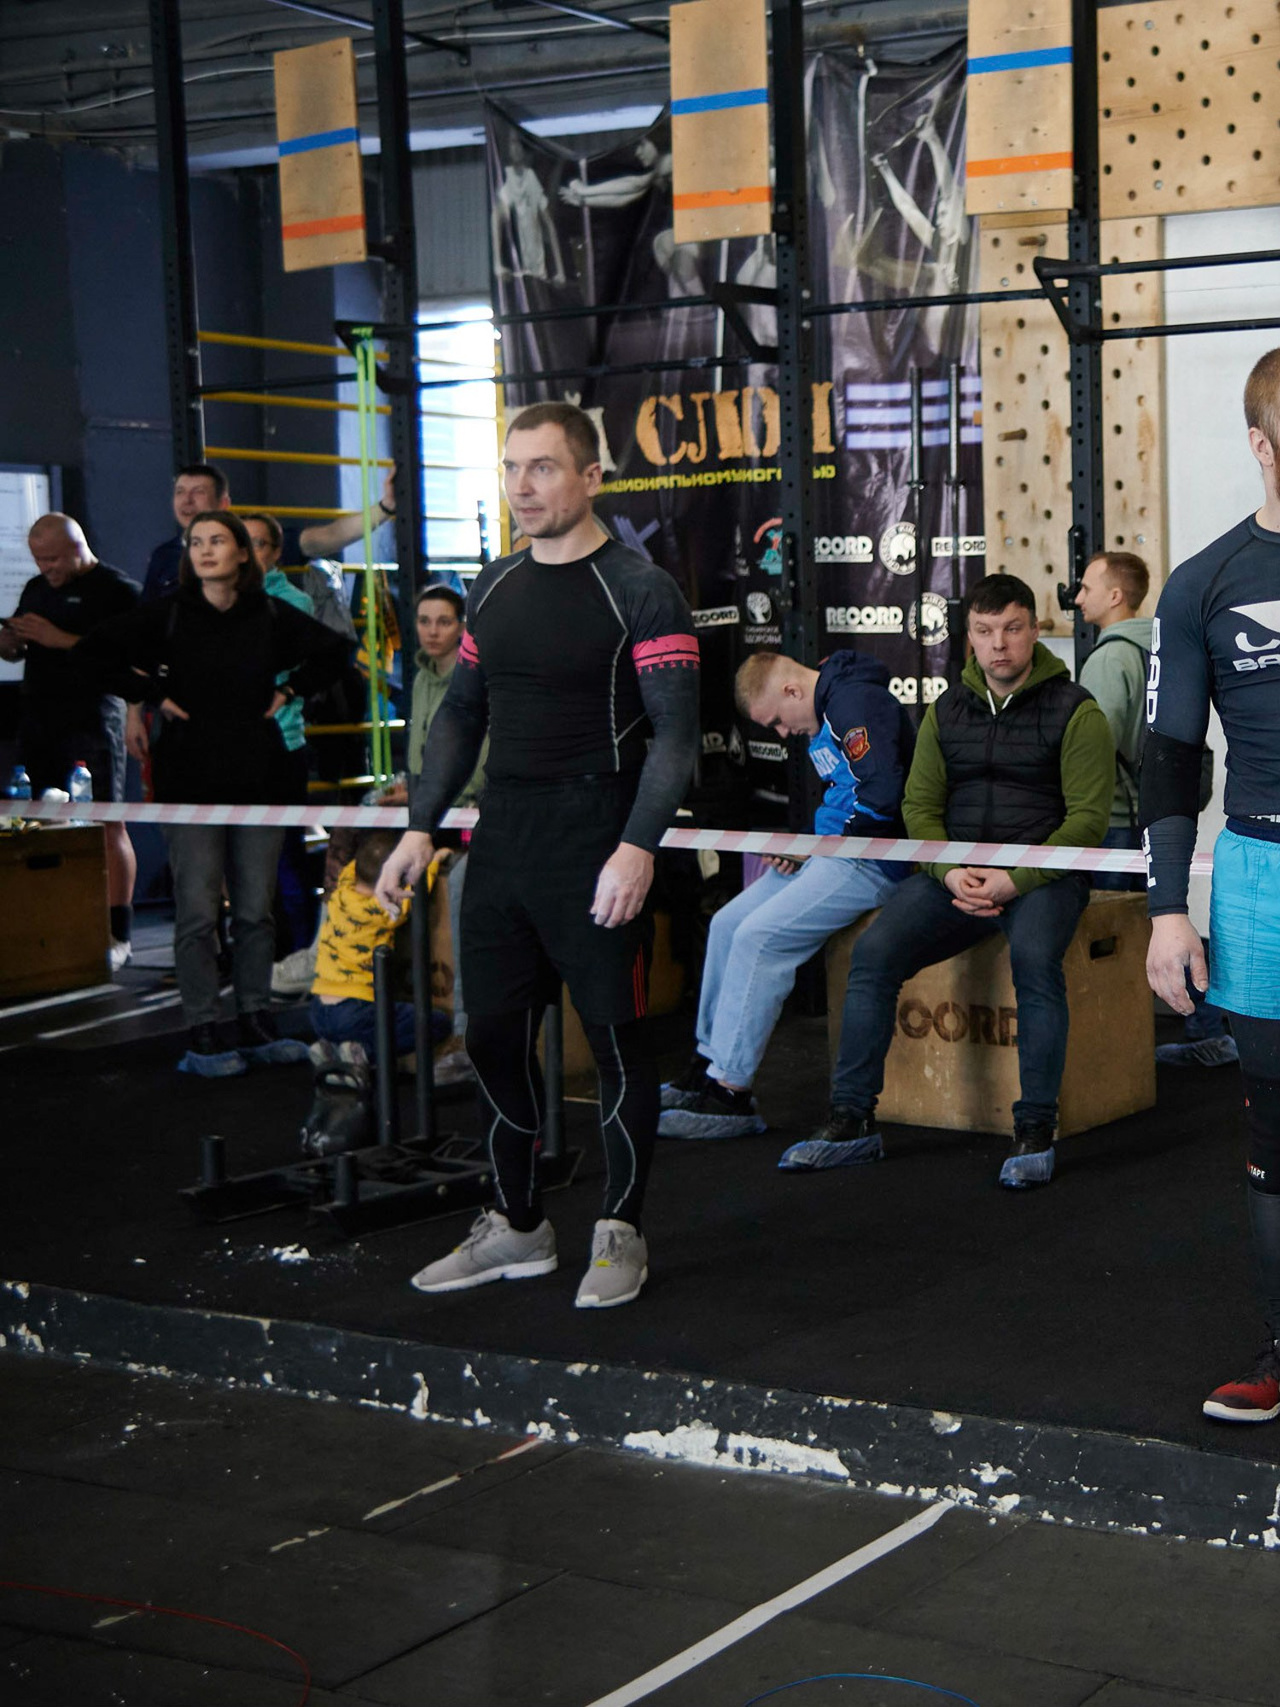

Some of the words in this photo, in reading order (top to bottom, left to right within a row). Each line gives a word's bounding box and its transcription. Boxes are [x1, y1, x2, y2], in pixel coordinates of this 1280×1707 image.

[814, 536, 873, 556] CORD
[935, 540, 986, 552] REORD
[826, 606, 903, 625] RECORD
[889, 676, 949, 697] CORD
